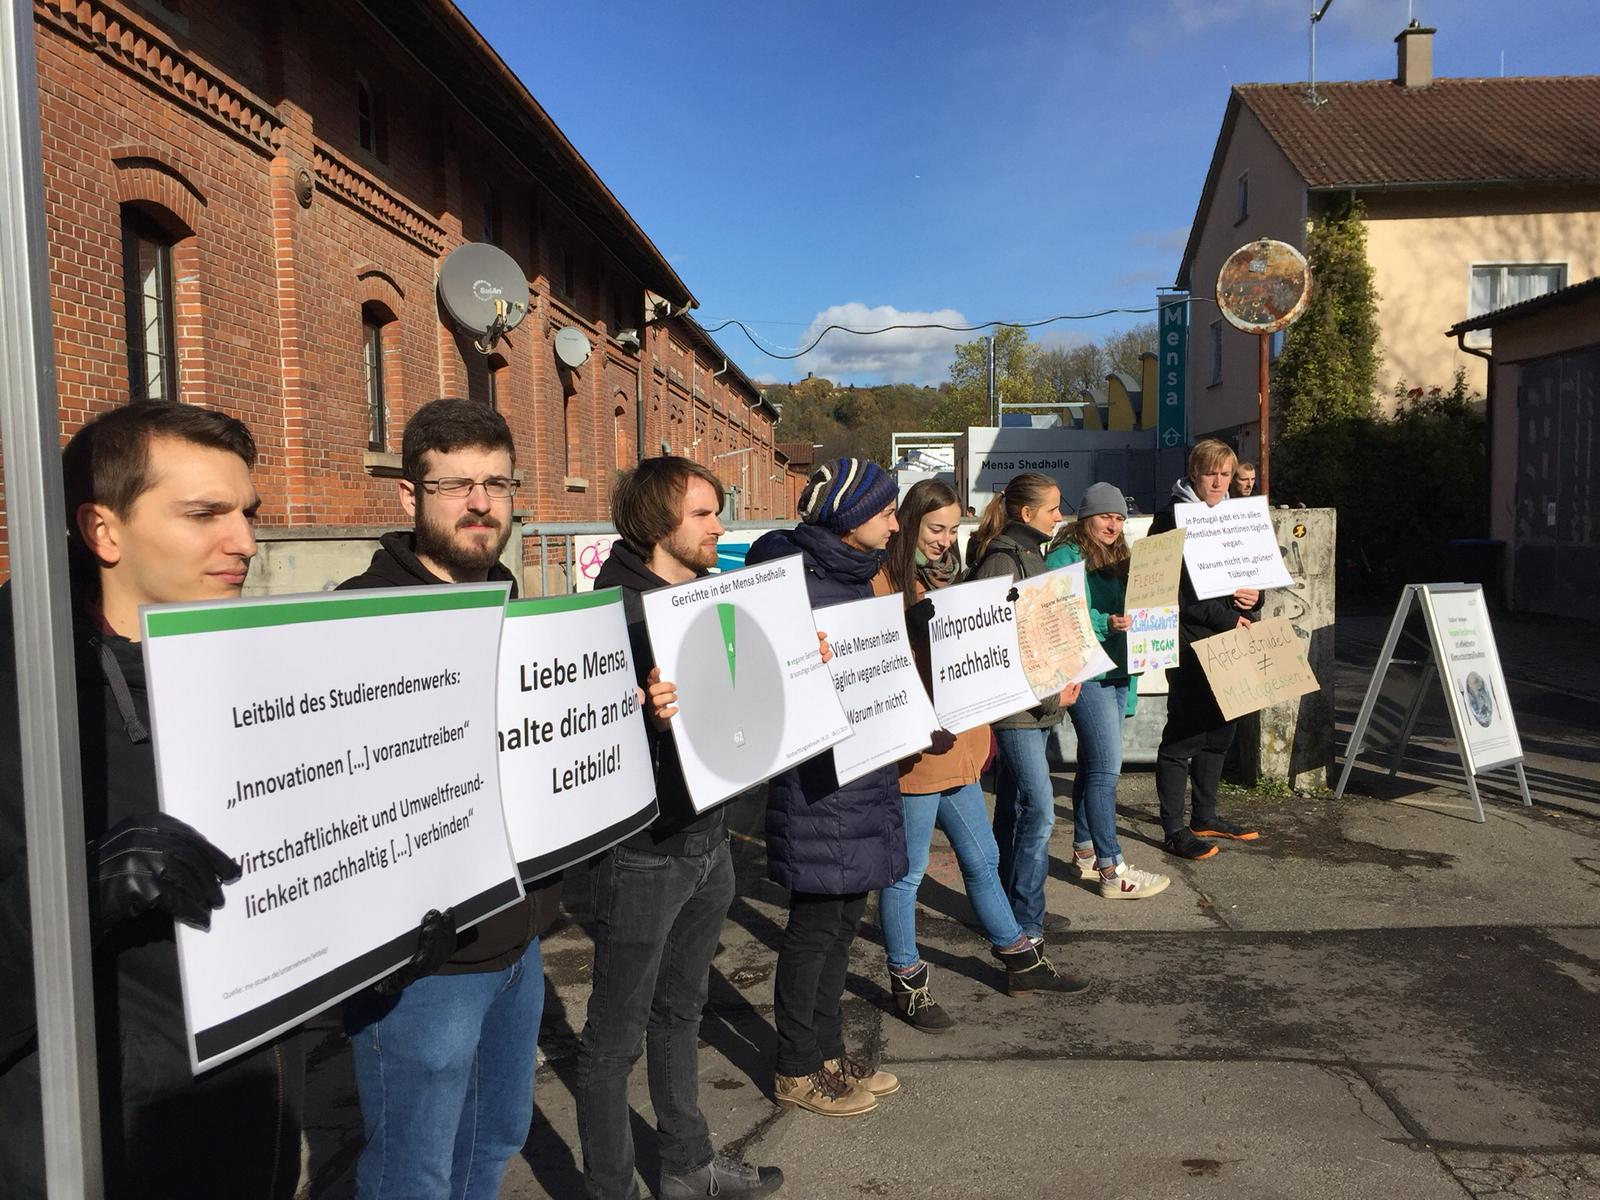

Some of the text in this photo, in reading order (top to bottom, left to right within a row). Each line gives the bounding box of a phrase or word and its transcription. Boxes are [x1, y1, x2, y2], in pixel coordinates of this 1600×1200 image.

[1164, 306, 1182, 406] Mensa
[982, 459, 1070, 470] Mensa Shedhalle
[1193, 515, 1218, 525] Portugal
[1219, 513, 1231, 524] gibt
[1247, 511, 1262, 519] allen
[1222, 525, 1250, 536] Kantinen
[1250, 523, 1270, 534] täglich
[1222, 539, 1244, 548] vegan.
[1197, 560, 1223, 571] Warum
[1224, 557, 1241, 567] nicht
[1241, 556, 1251, 564] im
[1227, 568, 1260, 580] Tübingen?
[671, 567, 786, 607] Gerichte in der Mensa Shedhalle
[931, 604, 1013, 643] Milchprodukte
[830, 628, 900, 658] Viele Mensen haben
[1151, 639, 1175, 652] VEGAN
[520, 649, 628, 692] Liebe Mensa,
[857, 663, 880, 684] vegane
[881, 654, 911, 675] Gerichte.
[948, 645, 1011, 682] nachhaltig
[232, 668, 461, 728] Leitbild des Studierendenwerks:
[560, 703, 597, 738] dich
[601, 703, 618, 726] an
[621, 687, 640, 718] dein
[847, 689, 908, 725] Warum ihr nicht?
[734, 731, 744, 743] 62
[226, 756, 344, 810] „Innovationen
[552, 743, 621, 794] Leitbild!
[372, 801, 398, 829] und
[399, 773, 484, 818] Umweltfreund-
[245, 876, 310, 919] lichkeit
[313, 846, 389, 892] nachhaltig
